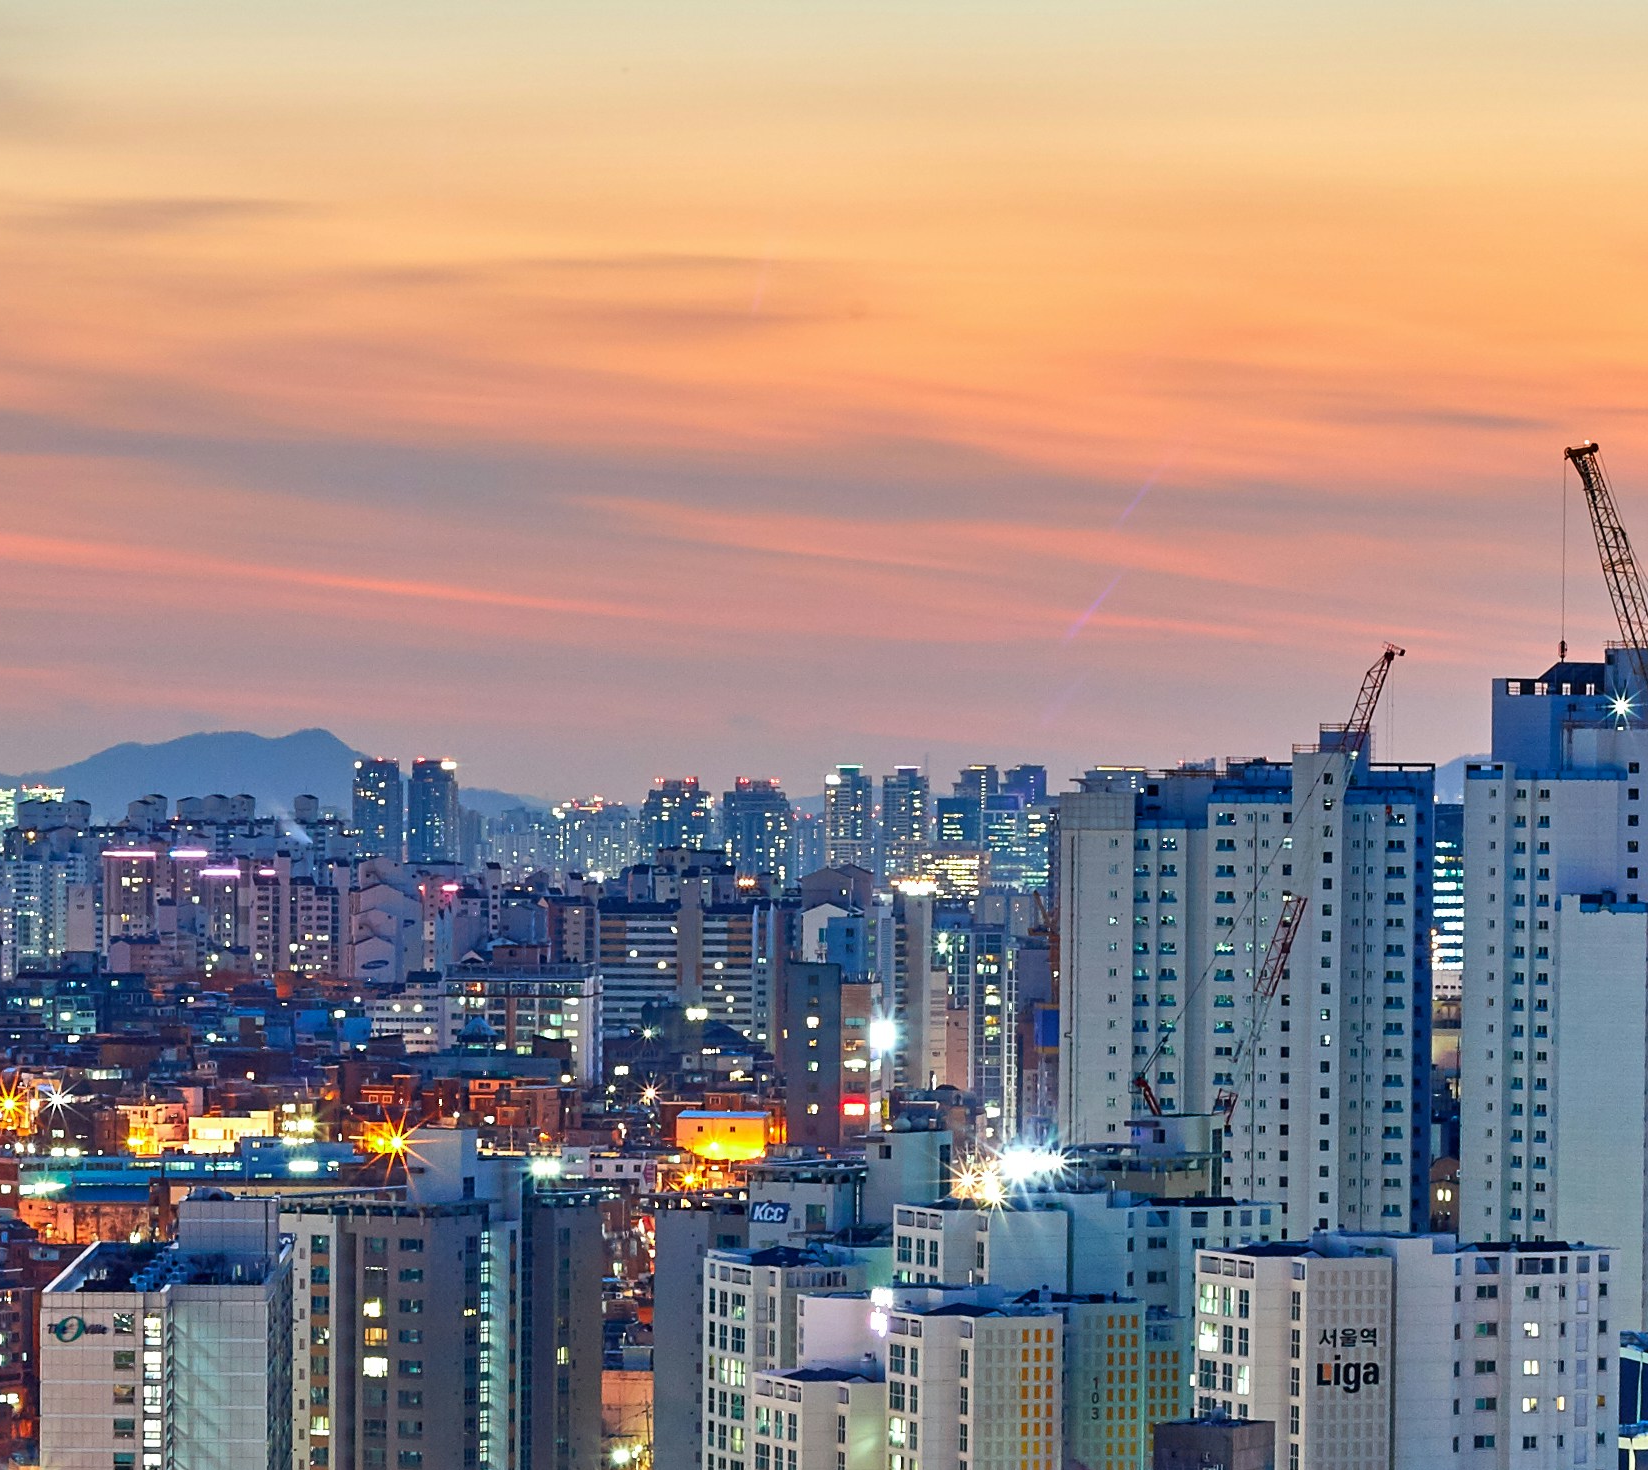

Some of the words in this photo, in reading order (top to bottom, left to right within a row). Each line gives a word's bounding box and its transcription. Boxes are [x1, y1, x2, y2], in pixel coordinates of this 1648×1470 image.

[753, 1203, 784, 1221] KCC
[1318, 1327, 1377, 1348] 서울역
[1316, 1354, 1380, 1394] Liga
[1091, 1376, 1100, 1420] 103
